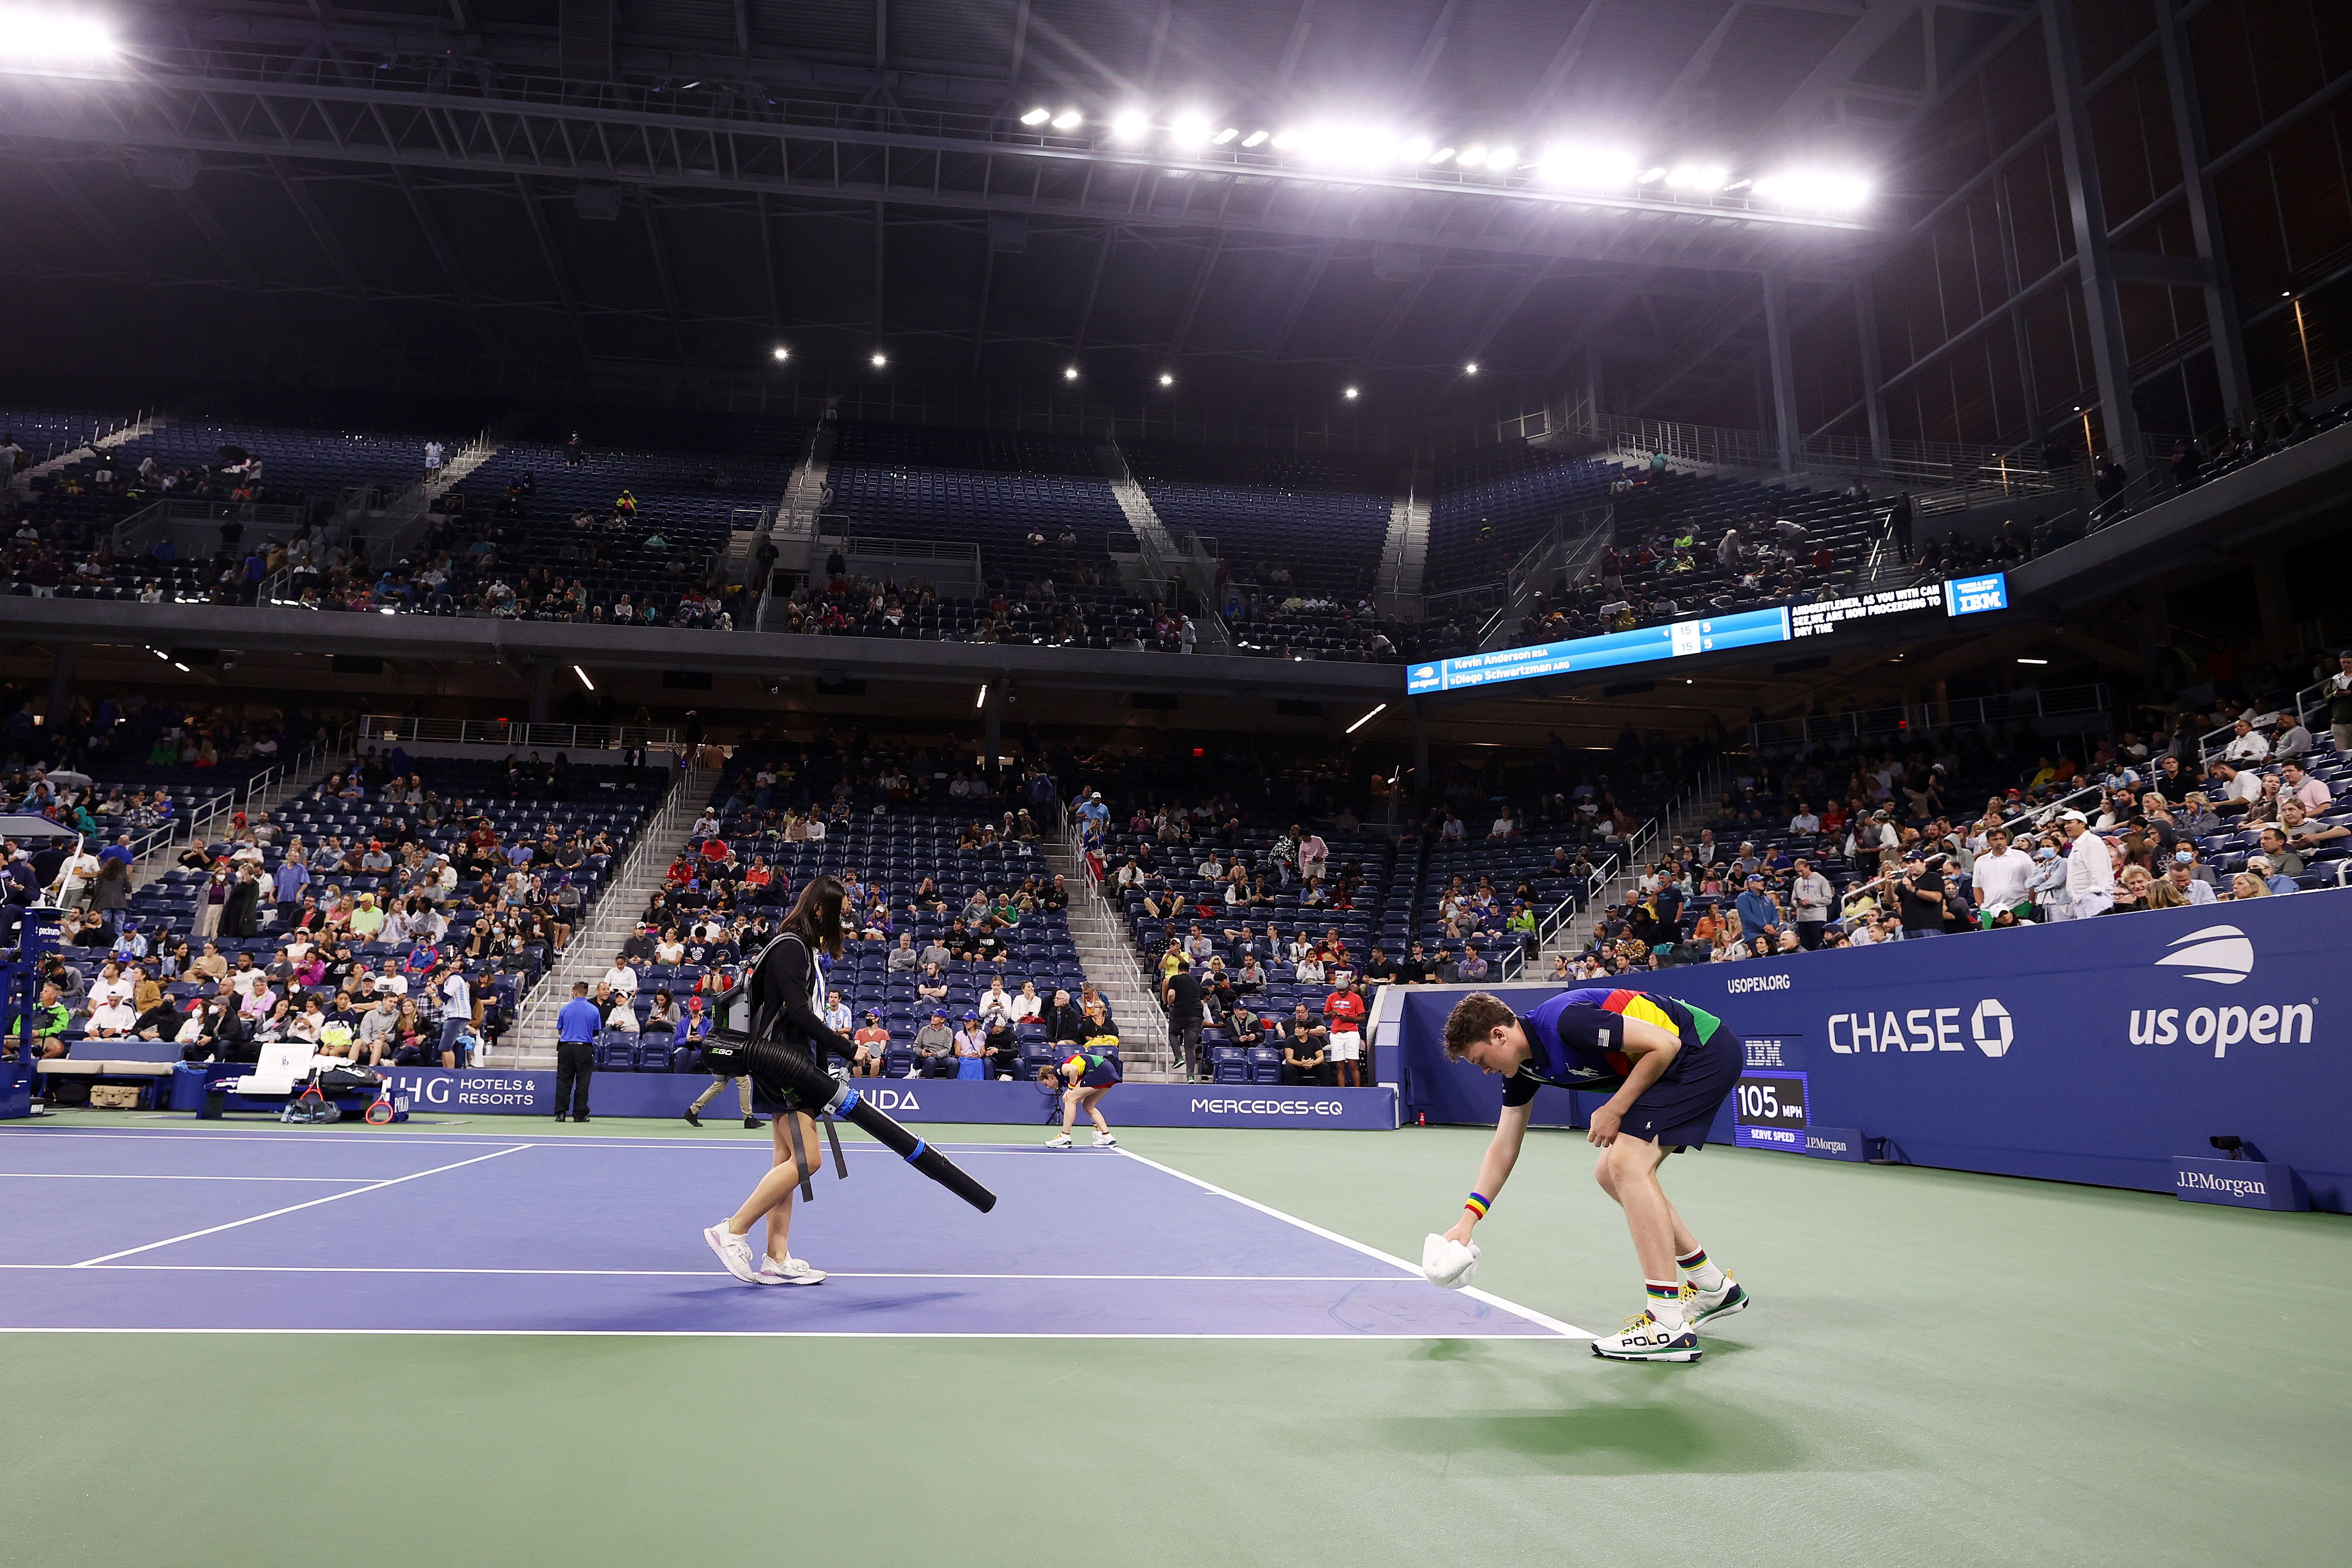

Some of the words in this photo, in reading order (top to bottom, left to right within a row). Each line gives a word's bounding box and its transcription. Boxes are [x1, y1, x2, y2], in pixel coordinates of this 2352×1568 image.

[1863, 595, 1876, 606] AS
[1876, 592, 1895, 603] YOU
[1895, 588, 1918, 600] WITH
[1920, 585, 1940, 596] CAN
[1959, 591, 2002, 612] IBM
[1826, 611, 1844, 622] ARE
[1846, 607, 1866, 619] NOW
[1868, 598, 1926, 615] PROCEEDING
[1927, 595, 1941, 606] TO
[1681, 626, 1691, 635] 15
[1703, 622, 1712, 633] 5
[1794, 625, 1813, 637] DRY
[1814, 623, 1833, 634] THE
[1682, 643, 1692, 651] 15
[1704, 638, 1713, 649] 5
[1455, 657, 1482, 669] Kevin
[1484, 652, 1530, 665] Anderson
[1532, 649, 1548, 658] RSA
[1455, 673, 1483, 685] Diego
[1485, 664, 1552, 680] Schwartzman
[1553, 661, 1570, 671] ARG
[1727, 974, 1791, 993] USOPEN.ORG
[1828, 1007, 1965, 1054] CHASE
[2129, 1008, 2179, 1045] us
[2185, 1003, 2314, 1058] open
[711, 1048, 733, 1056] EGO
[1745, 1040, 1783, 1066] IBM
[460, 1078, 522, 1091] HOTELS
[525, 1080, 535, 1091] &
[394, 1096, 409, 1113] POLO
[459, 1093, 534, 1106] RESORTS
[1191, 1099, 1343, 1115] MERCEDES-EQ
[1738, 1084, 1778, 1118] 105
[1782, 1105, 1803, 1118] MPH
[1751, 1129, 1772, 1141] SERVE
[1773, 1131, 1795, 1143] SPEED
[1806, 1136, 1846, 1154] J.P.Morgan
[2177, 1171, 2266, 1197] J.P.Morgan
[1622, 1333, 1670, 1347] POLO
